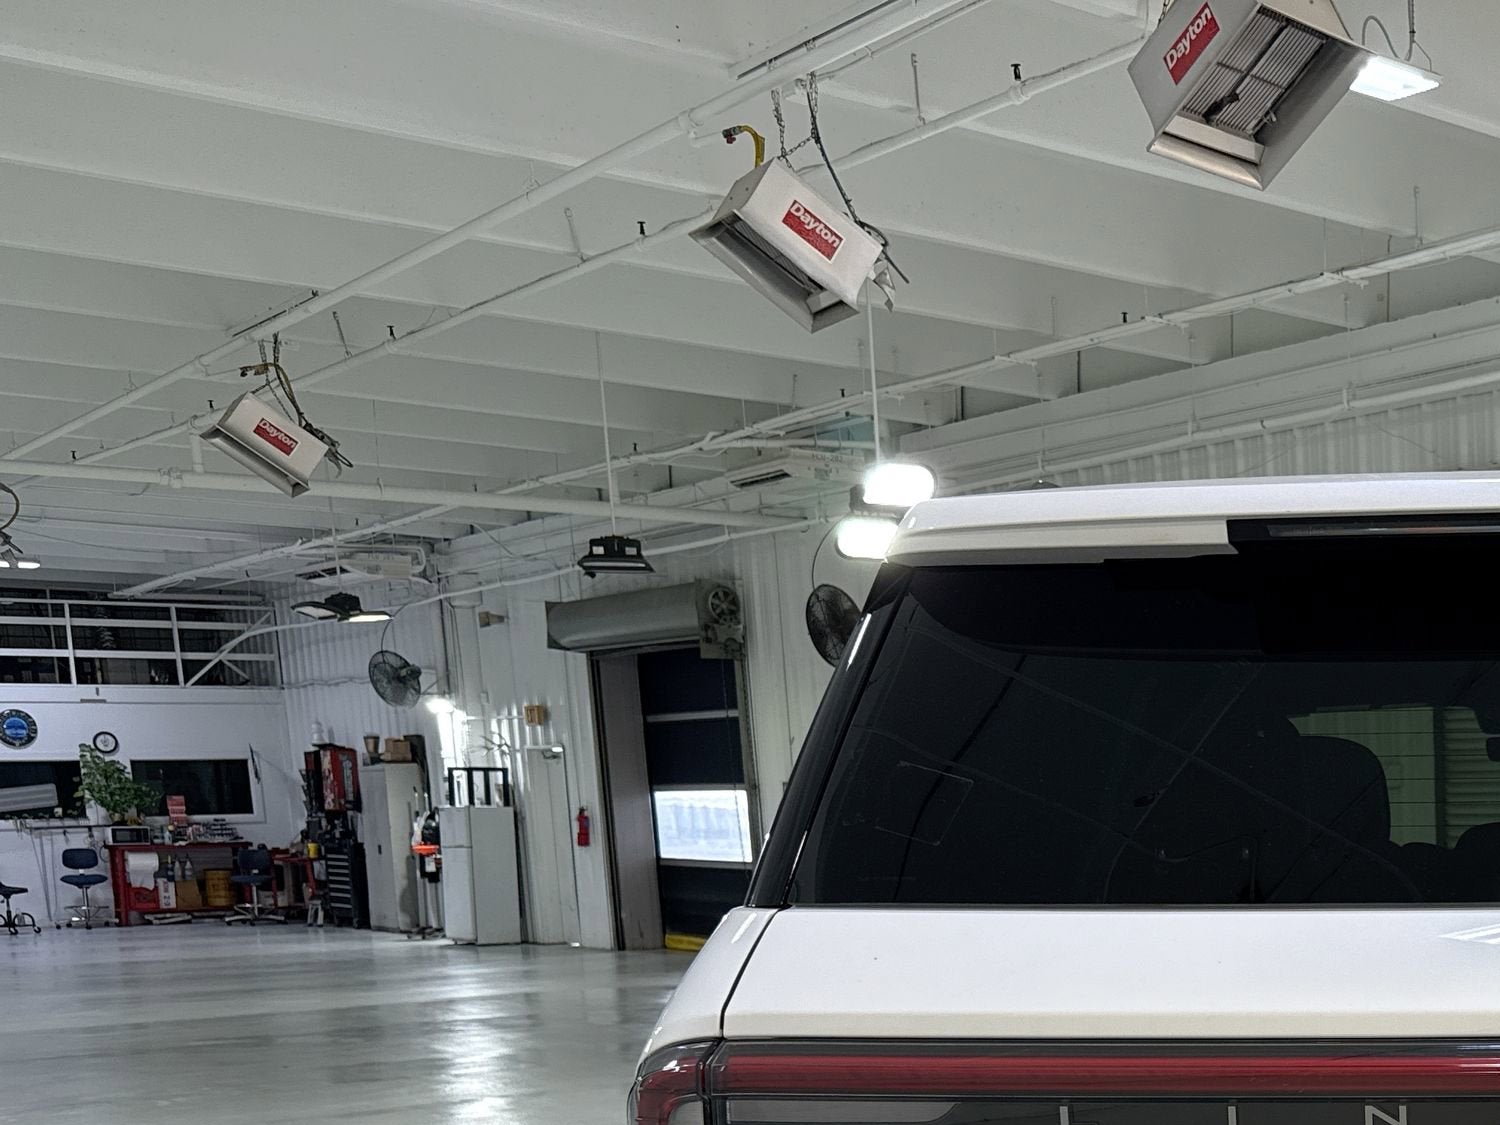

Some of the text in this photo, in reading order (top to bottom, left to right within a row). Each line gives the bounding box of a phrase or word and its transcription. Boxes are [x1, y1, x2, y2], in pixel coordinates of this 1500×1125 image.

[1166, 7, 1212, 70] Dayton
[790, 203, 840, 248] Dayton
[259, 420, 297, 448] Dayton
